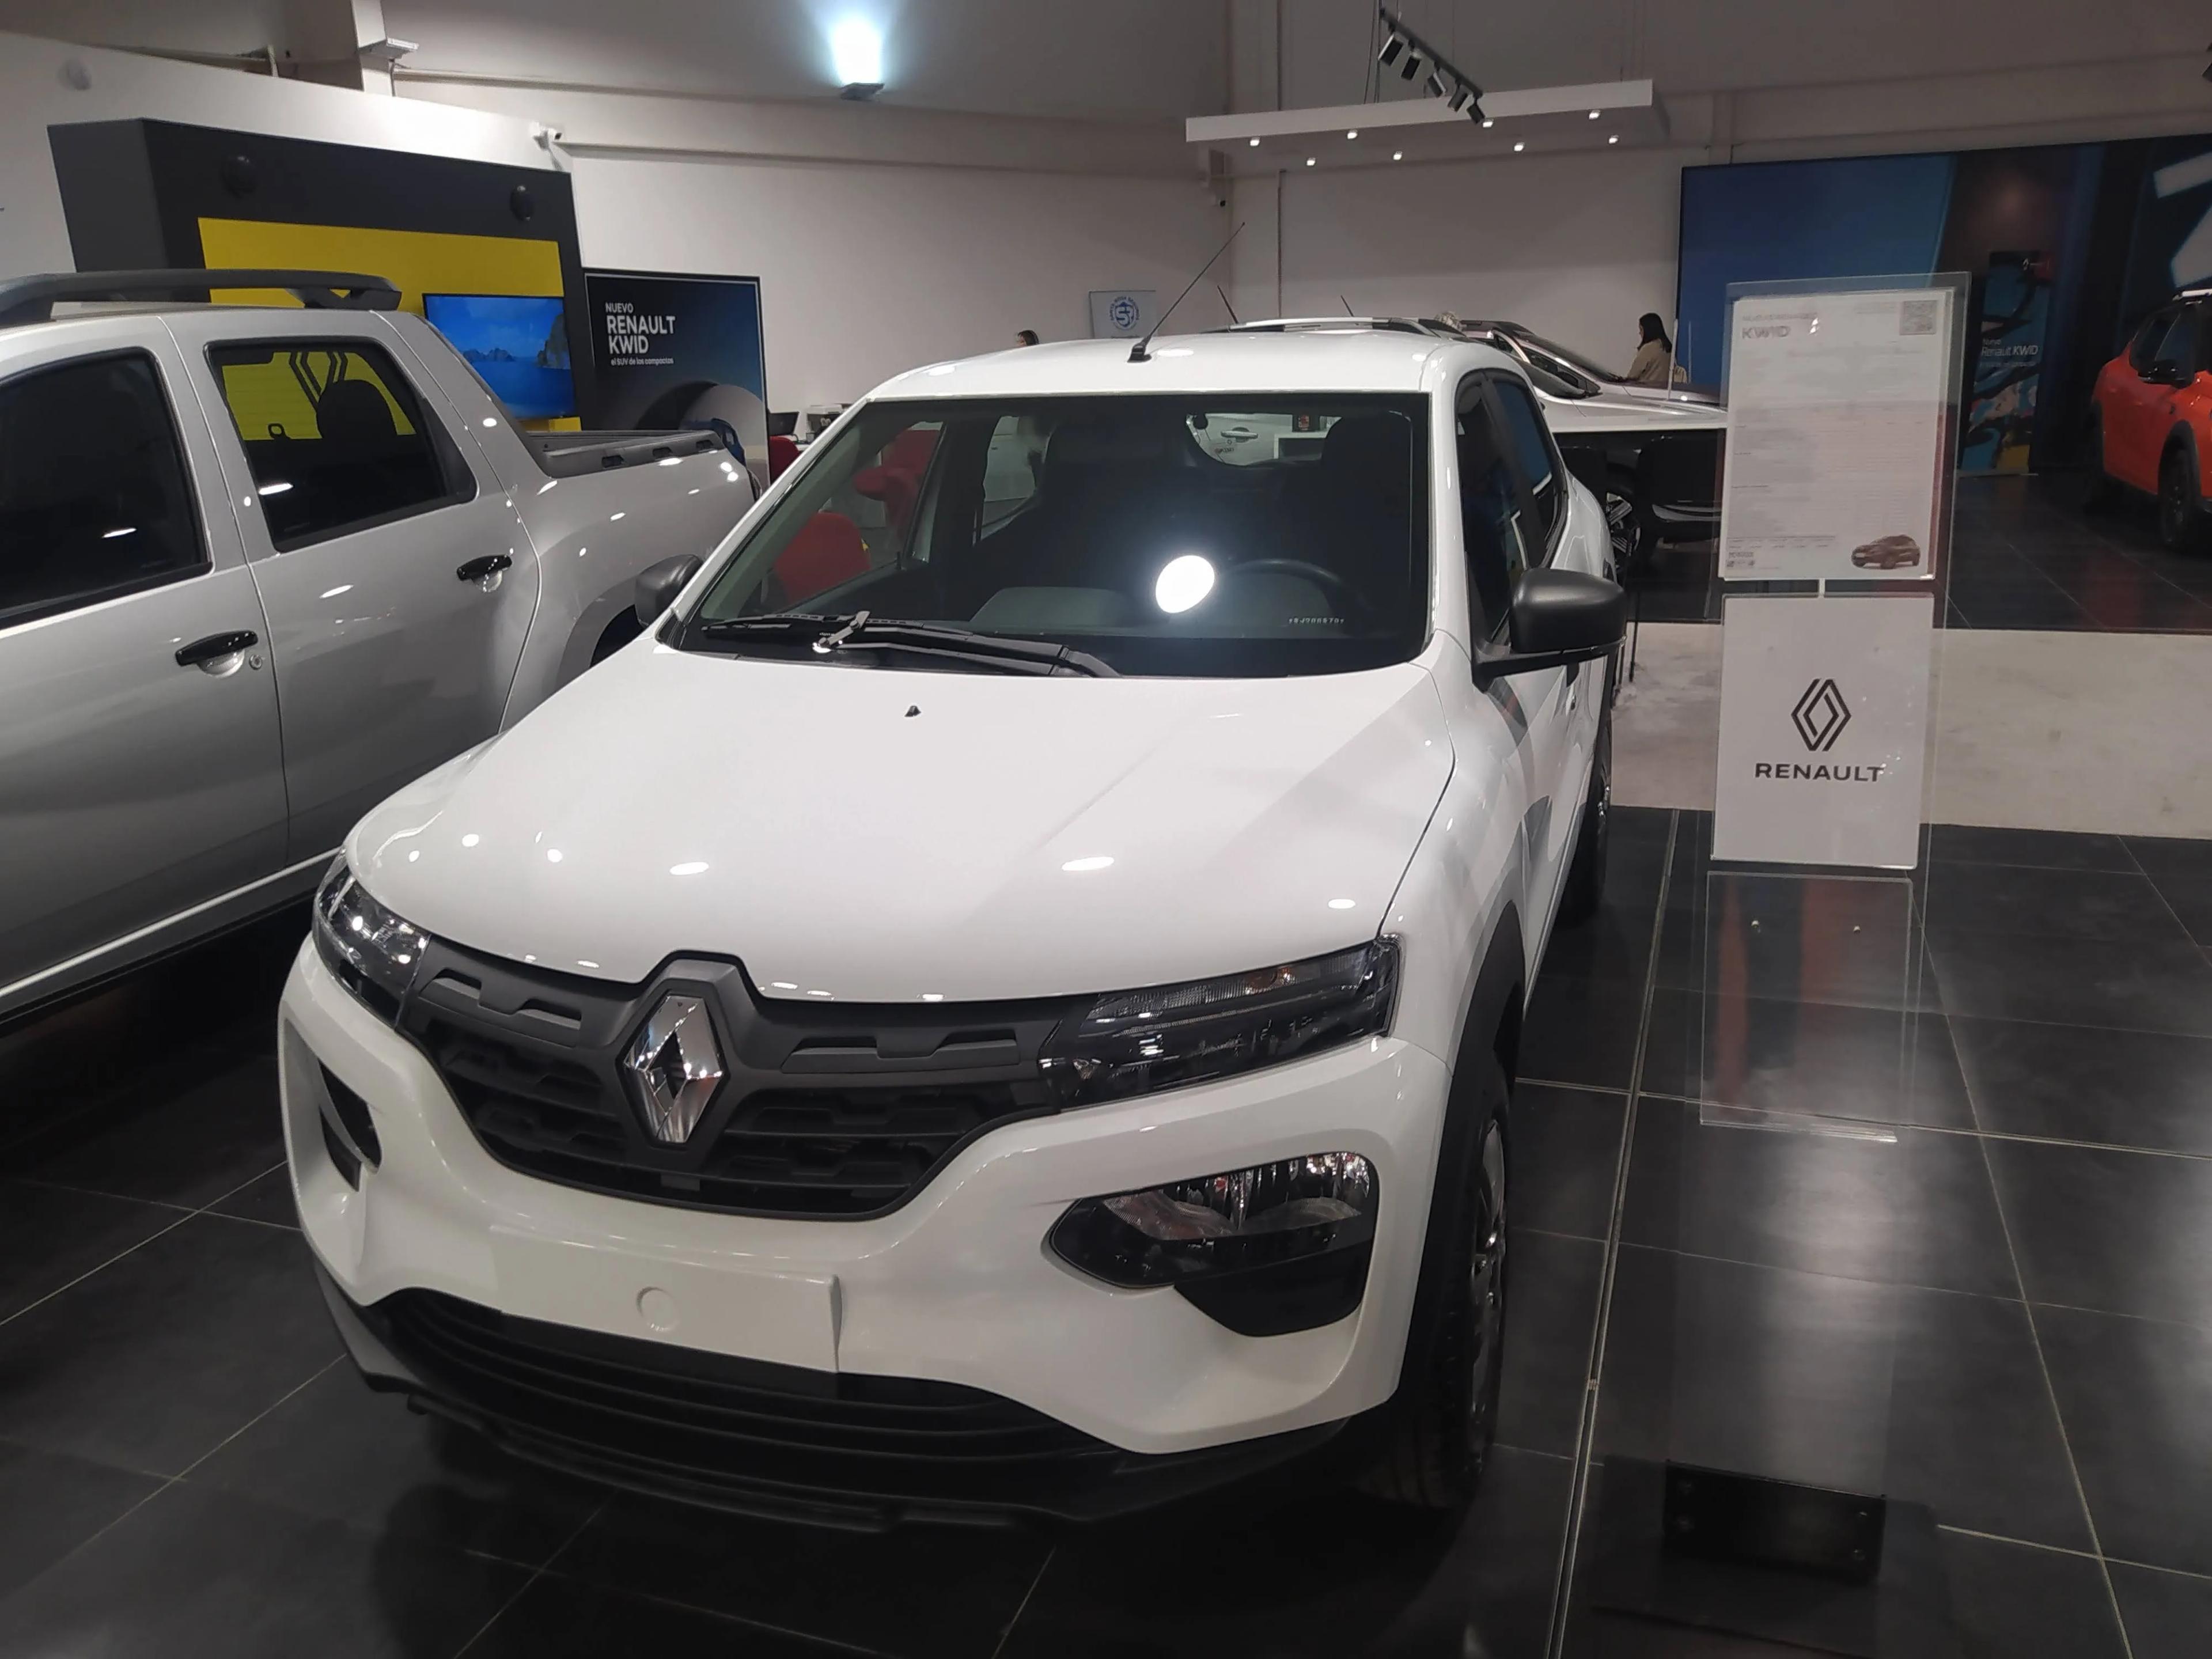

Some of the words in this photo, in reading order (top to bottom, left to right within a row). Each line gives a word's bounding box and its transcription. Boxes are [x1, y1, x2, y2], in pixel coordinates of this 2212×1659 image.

[605, 302, 634, 313] NUEVO
[607, 315, 676, 334] RENAULT
[1742, 325, 1791, 339] KWID
[609, 335, 649, 355] KWID
[1981, 346, 2012, 356] Renault
[2012, 344, 2039, 356] KWID
[611, 357, 616, 366] el
[617, 357, 628, 366] SUV
[629, 357, 636, 365] de
[645, 357, 674, 366] compactos
[1755, 762, 1885, 782] RENAULT
